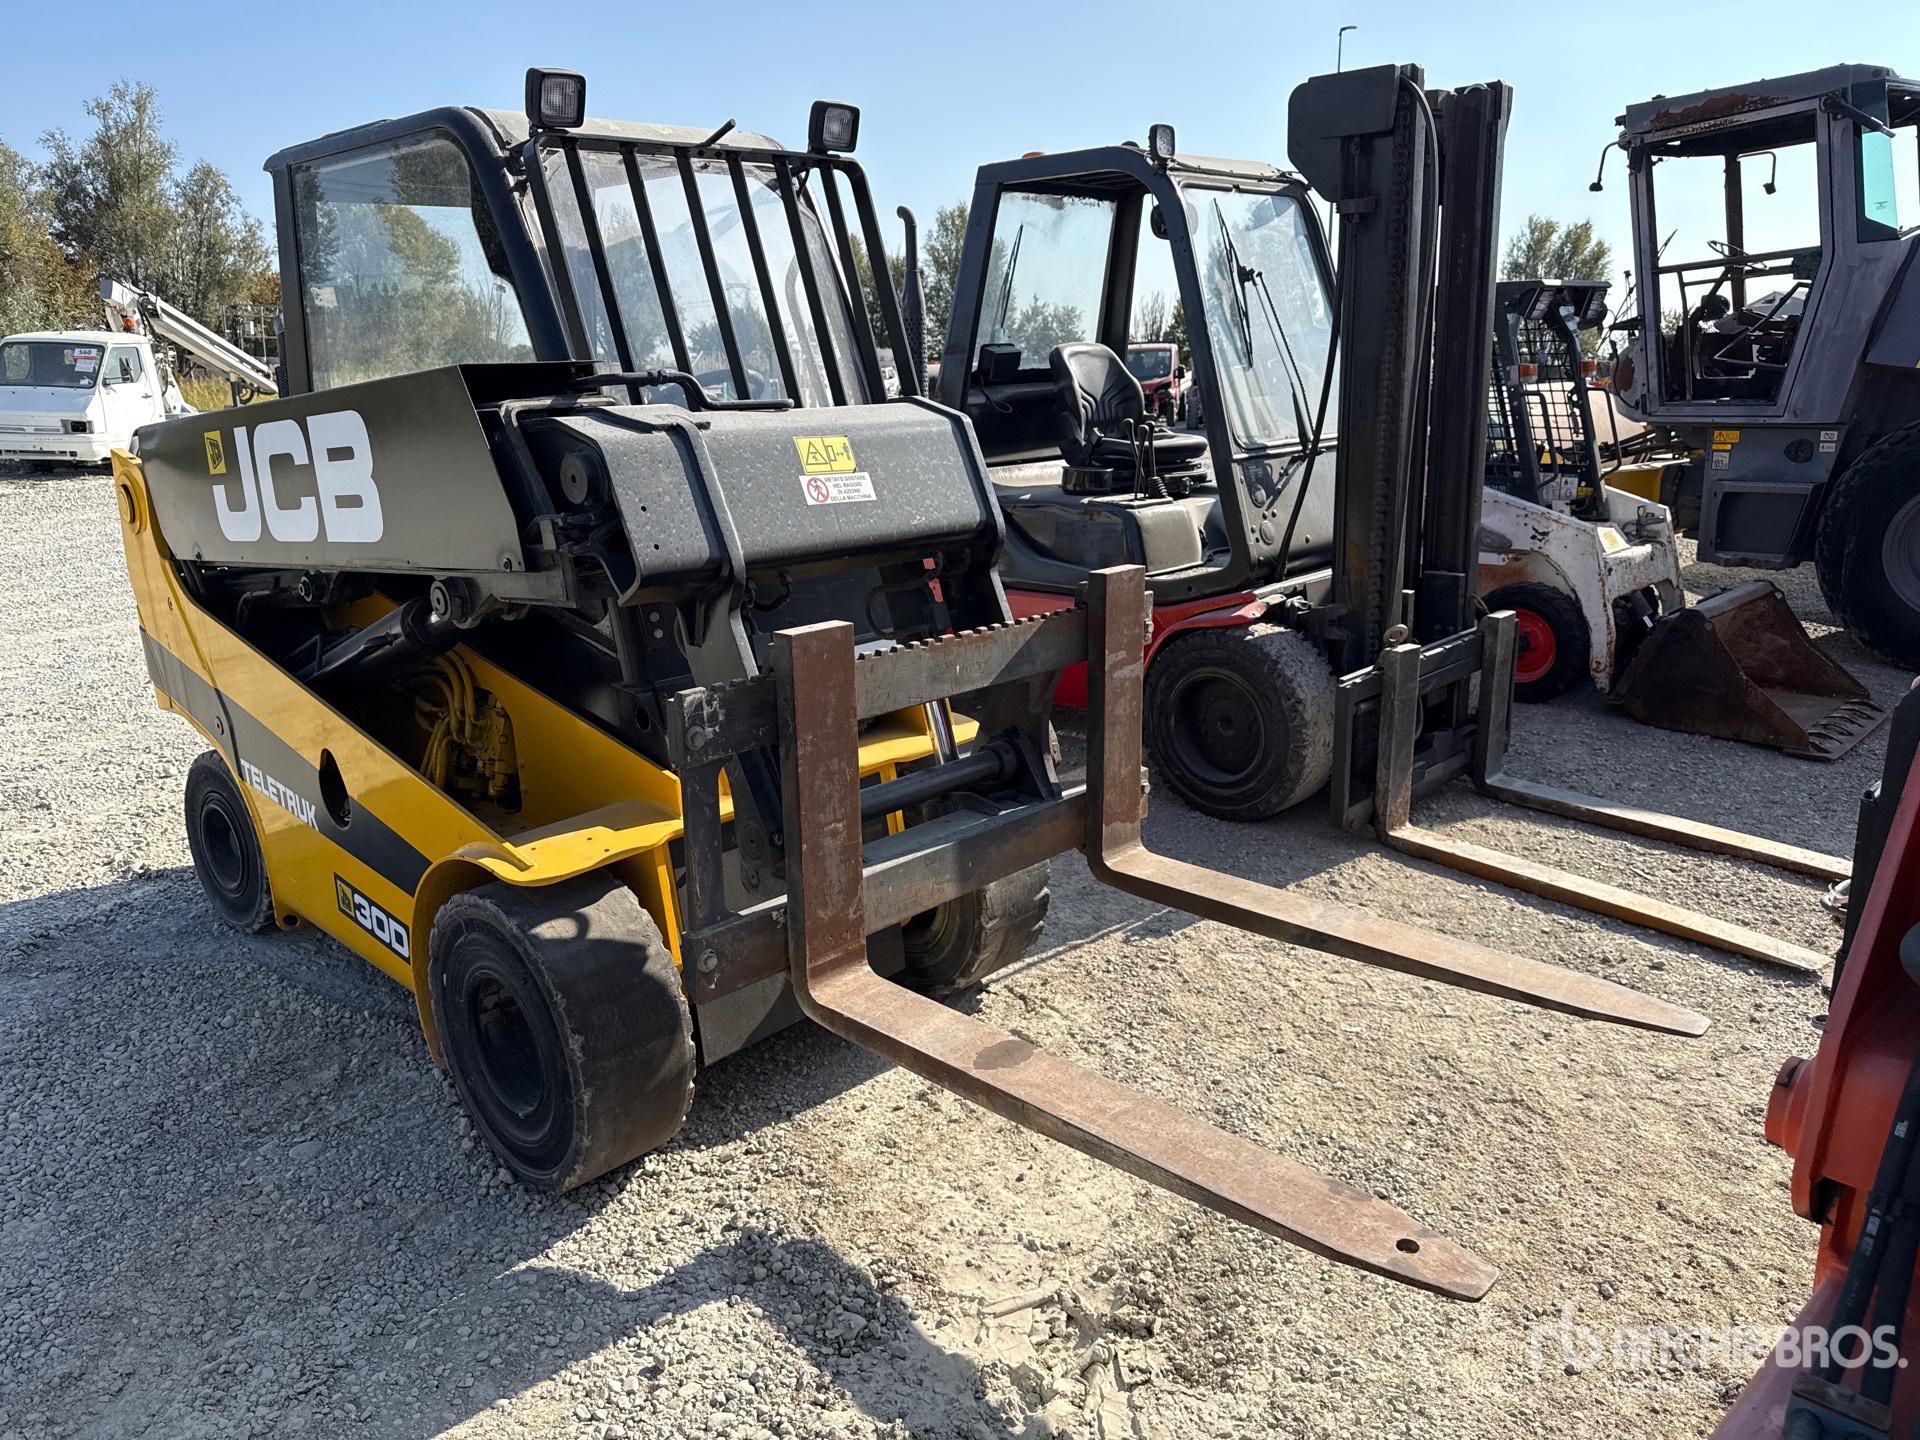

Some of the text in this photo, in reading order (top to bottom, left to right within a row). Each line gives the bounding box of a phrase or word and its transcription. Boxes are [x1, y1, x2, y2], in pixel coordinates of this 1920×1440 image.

[212, 410, 384, 542] JCB
[240, 758, 319, 832] TELETRUK
[353, 893, 410, 958] 30D
